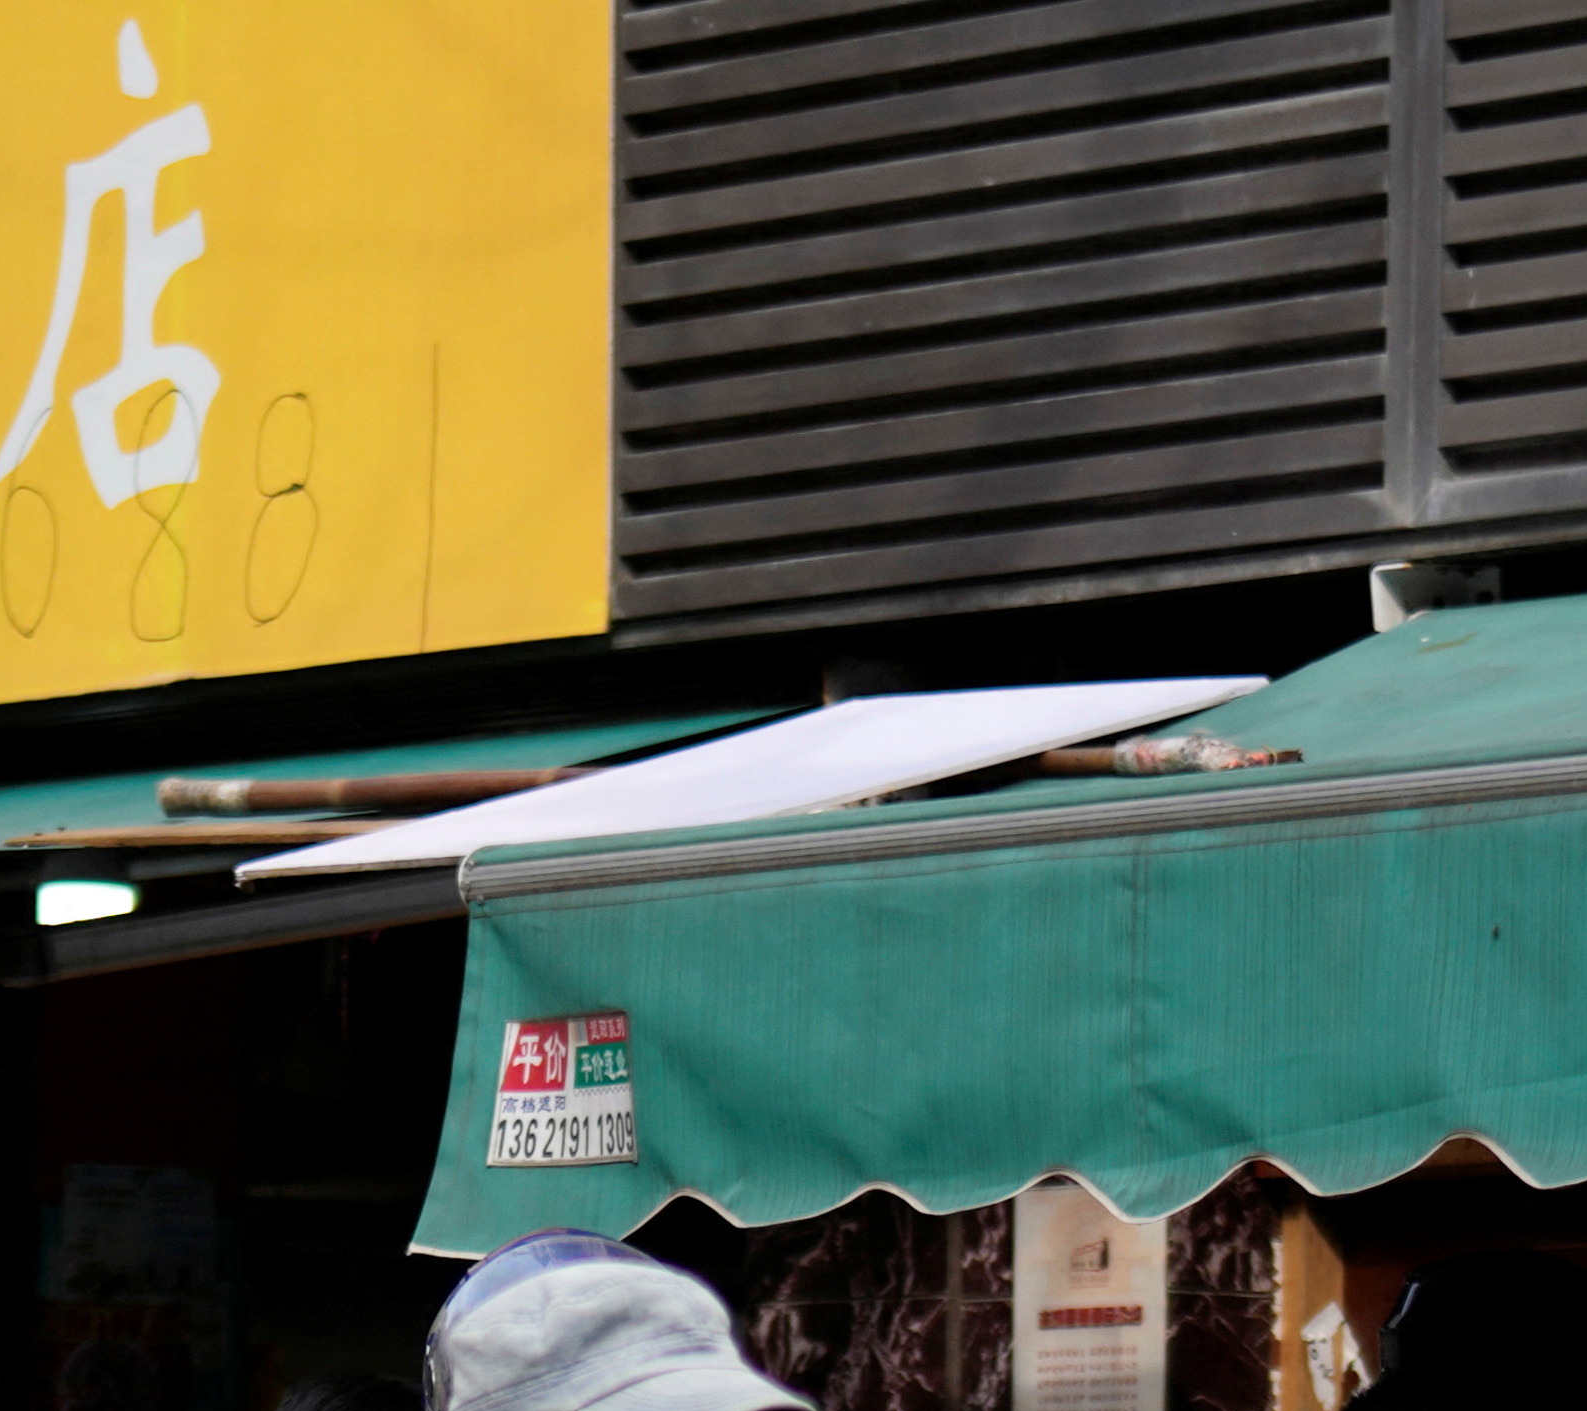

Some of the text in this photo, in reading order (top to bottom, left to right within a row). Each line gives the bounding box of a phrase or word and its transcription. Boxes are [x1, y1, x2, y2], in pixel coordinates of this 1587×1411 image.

[513, 1031, 567, 1085] 平价
[497, 1111, 635, 1159] 136 2191 1309
